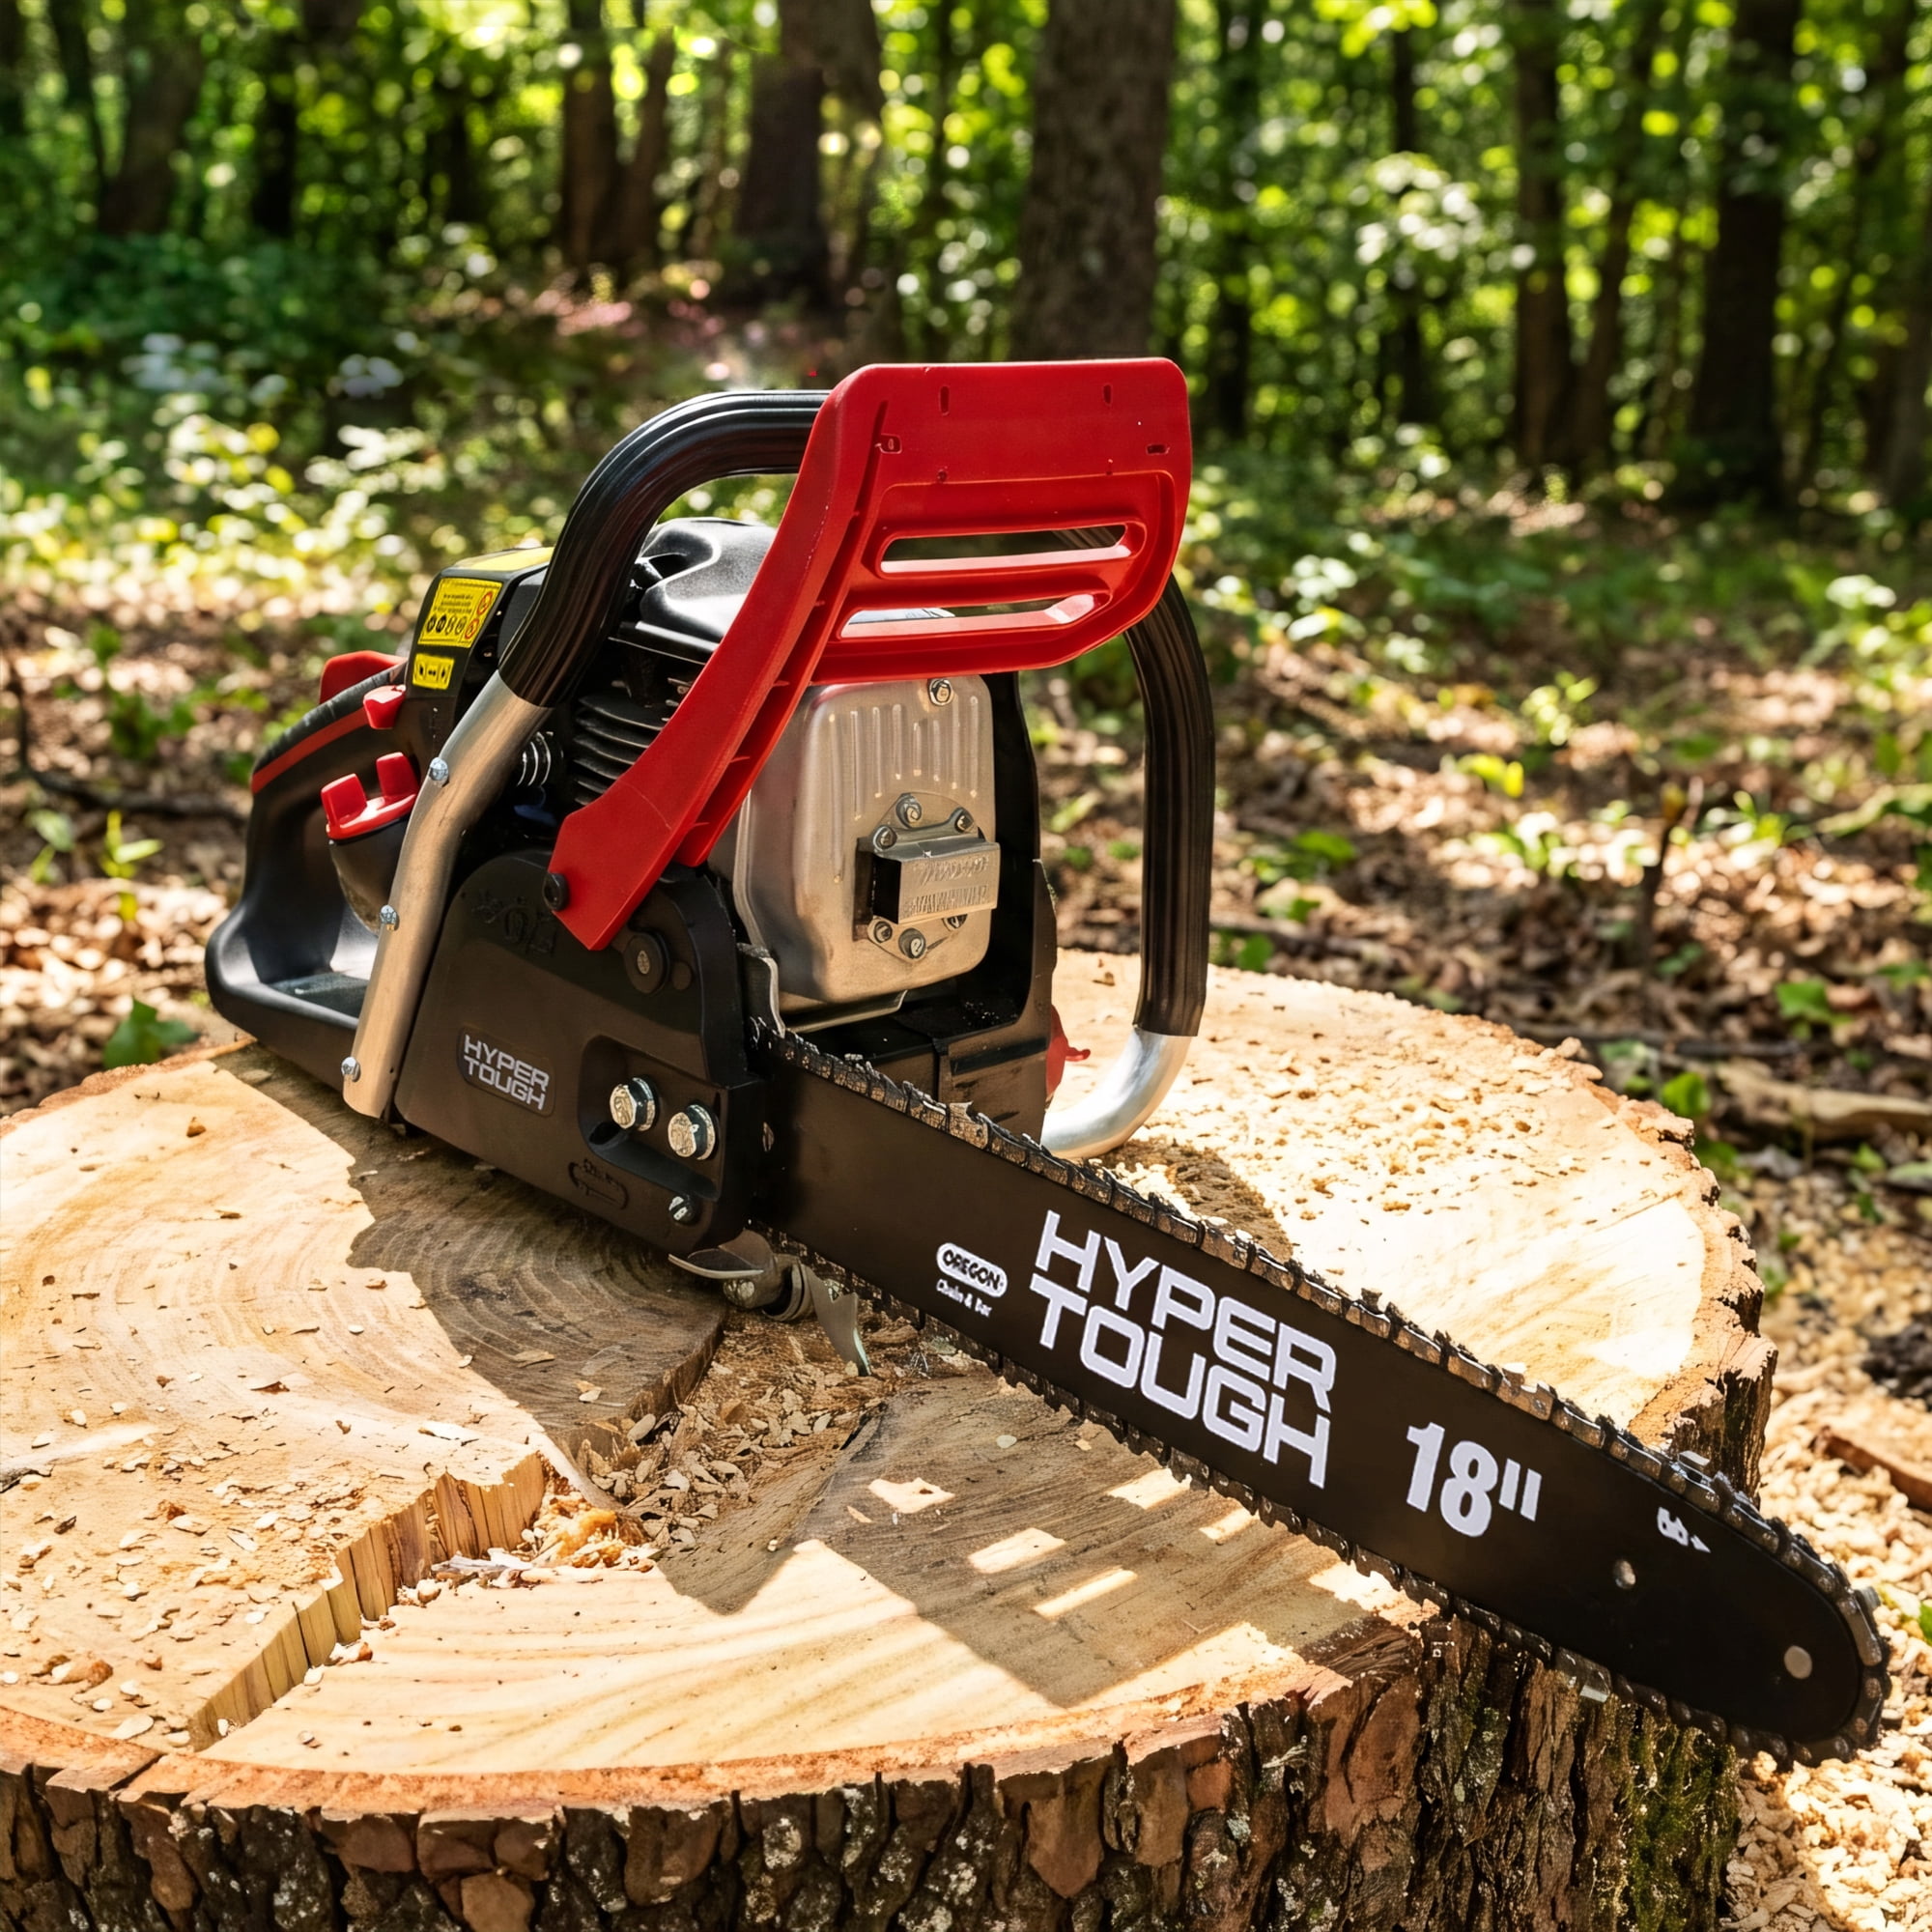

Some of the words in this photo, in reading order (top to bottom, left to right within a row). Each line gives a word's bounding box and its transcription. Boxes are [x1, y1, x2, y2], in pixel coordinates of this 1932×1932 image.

[464, 1034, 550, 1092] HYPER
[464, 1055, 546, 1110] TOUGH
[943, 1249, 1001, 1291] OREGON
[1035, 1209, 1337, 1413] HYPER
[1029, 1272, 1331, 1489] TOUGH
[1406, 1422, 1543, 1538] 18"
